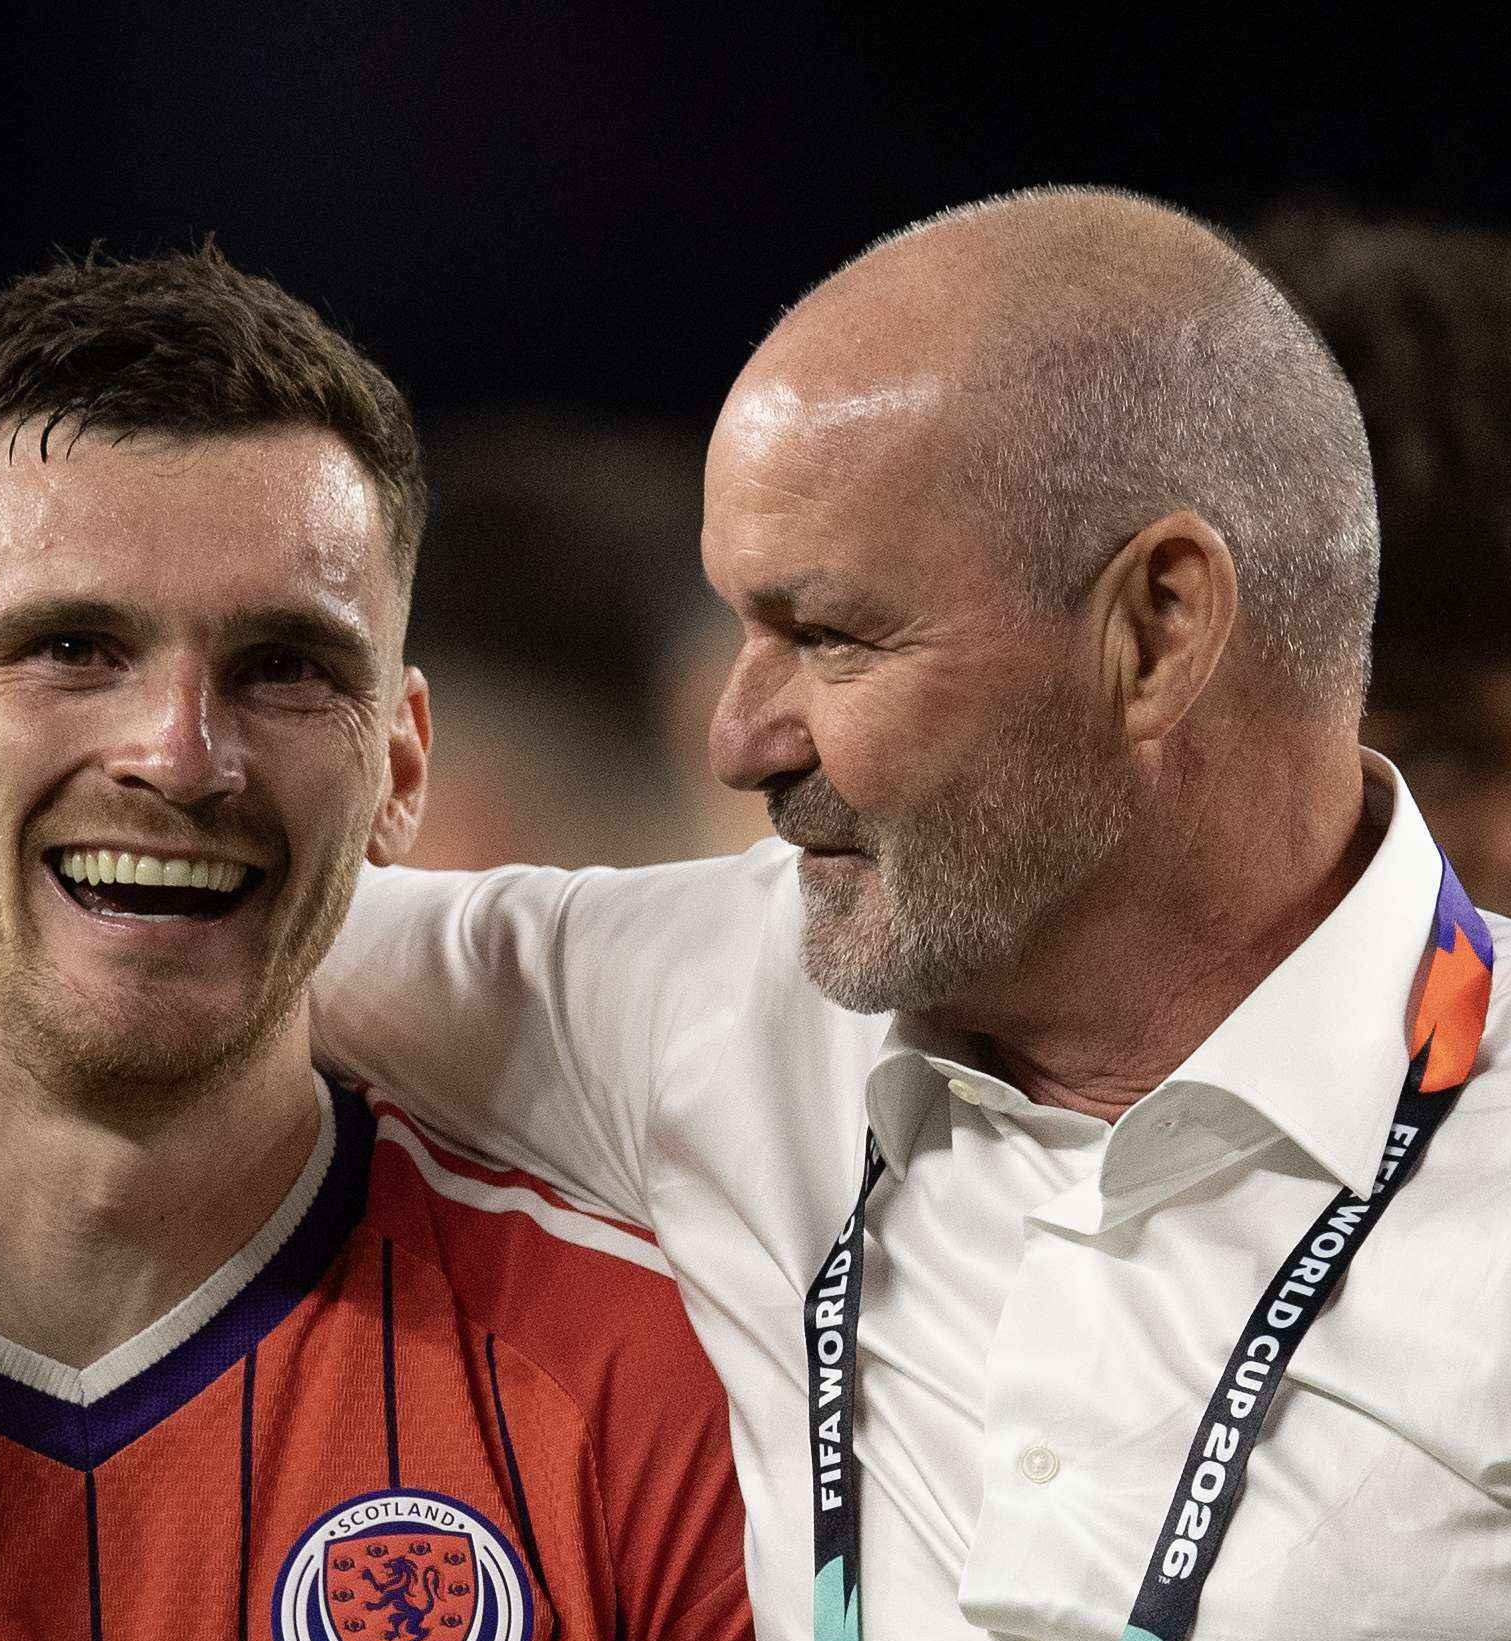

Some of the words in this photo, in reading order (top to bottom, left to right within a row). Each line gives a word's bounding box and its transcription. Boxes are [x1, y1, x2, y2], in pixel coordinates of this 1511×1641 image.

[1265, 1204, 1370, 1331] WORLD
[815, 1248, 852, 1411] WORLD
[1227, 1336, 1281, 1419] CUP
[337, 1501, 456, 1534] SCOTLAND
[819, 1410, 843, 1512] FIFA
[1162, 1421, 1242, 1580] 2026
